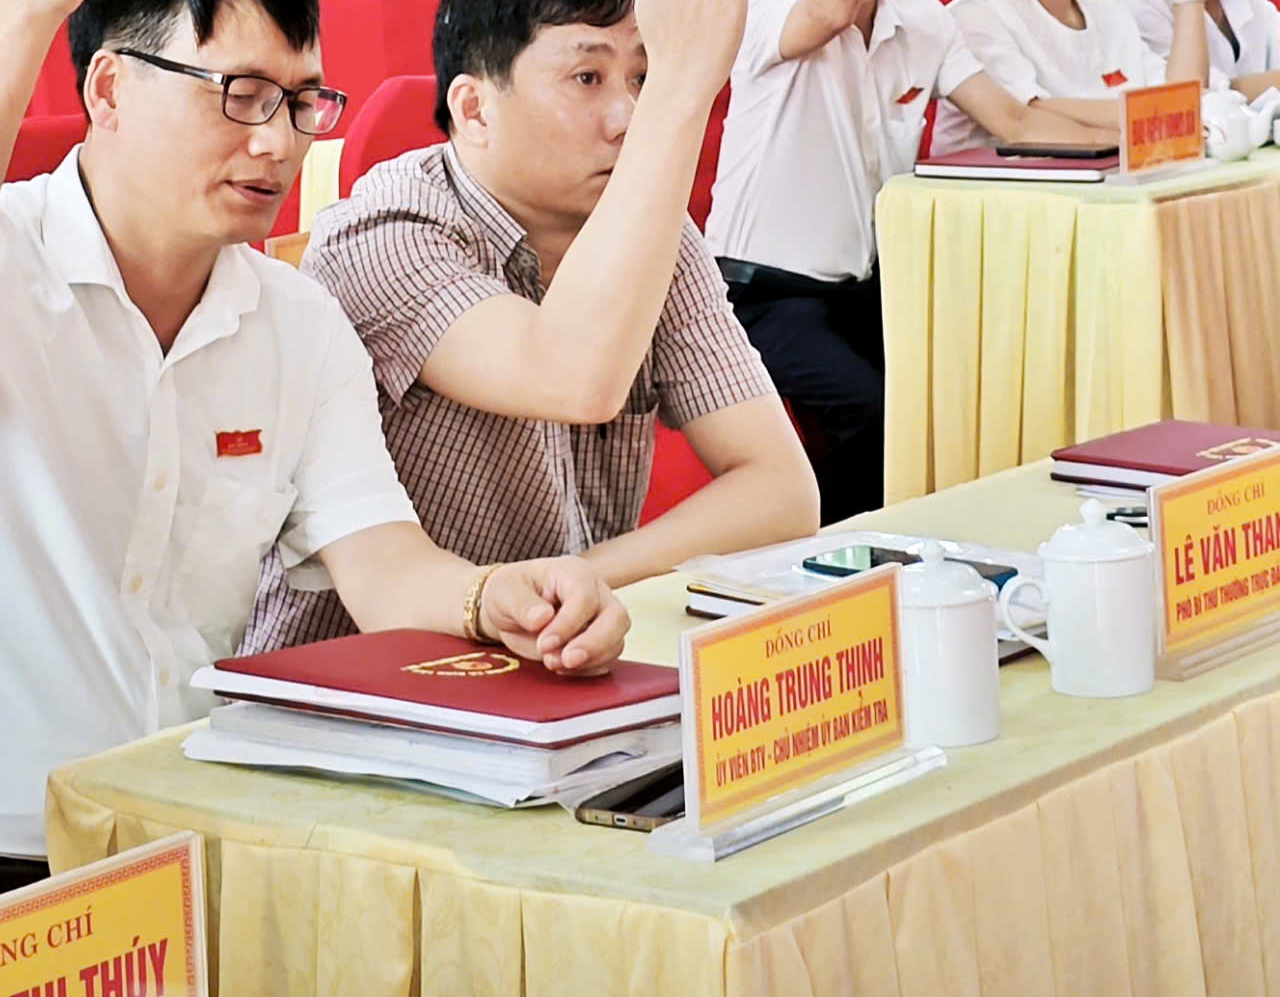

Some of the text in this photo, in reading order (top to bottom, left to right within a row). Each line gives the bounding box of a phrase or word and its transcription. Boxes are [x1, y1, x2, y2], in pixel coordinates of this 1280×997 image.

[1174, 533, 1196, 586] LÊ
[1200, 523, 1237, 576] VĂN
[775, 656, 833, 717] TRUNG
[750, 744, 766, 774] BTV
[833, 712, 851, 742] BAN
[873, 698, 888, 725] TRA
[46, 904, 94, 949] CHÍ
[79, 935, 169, 997] THÚY
